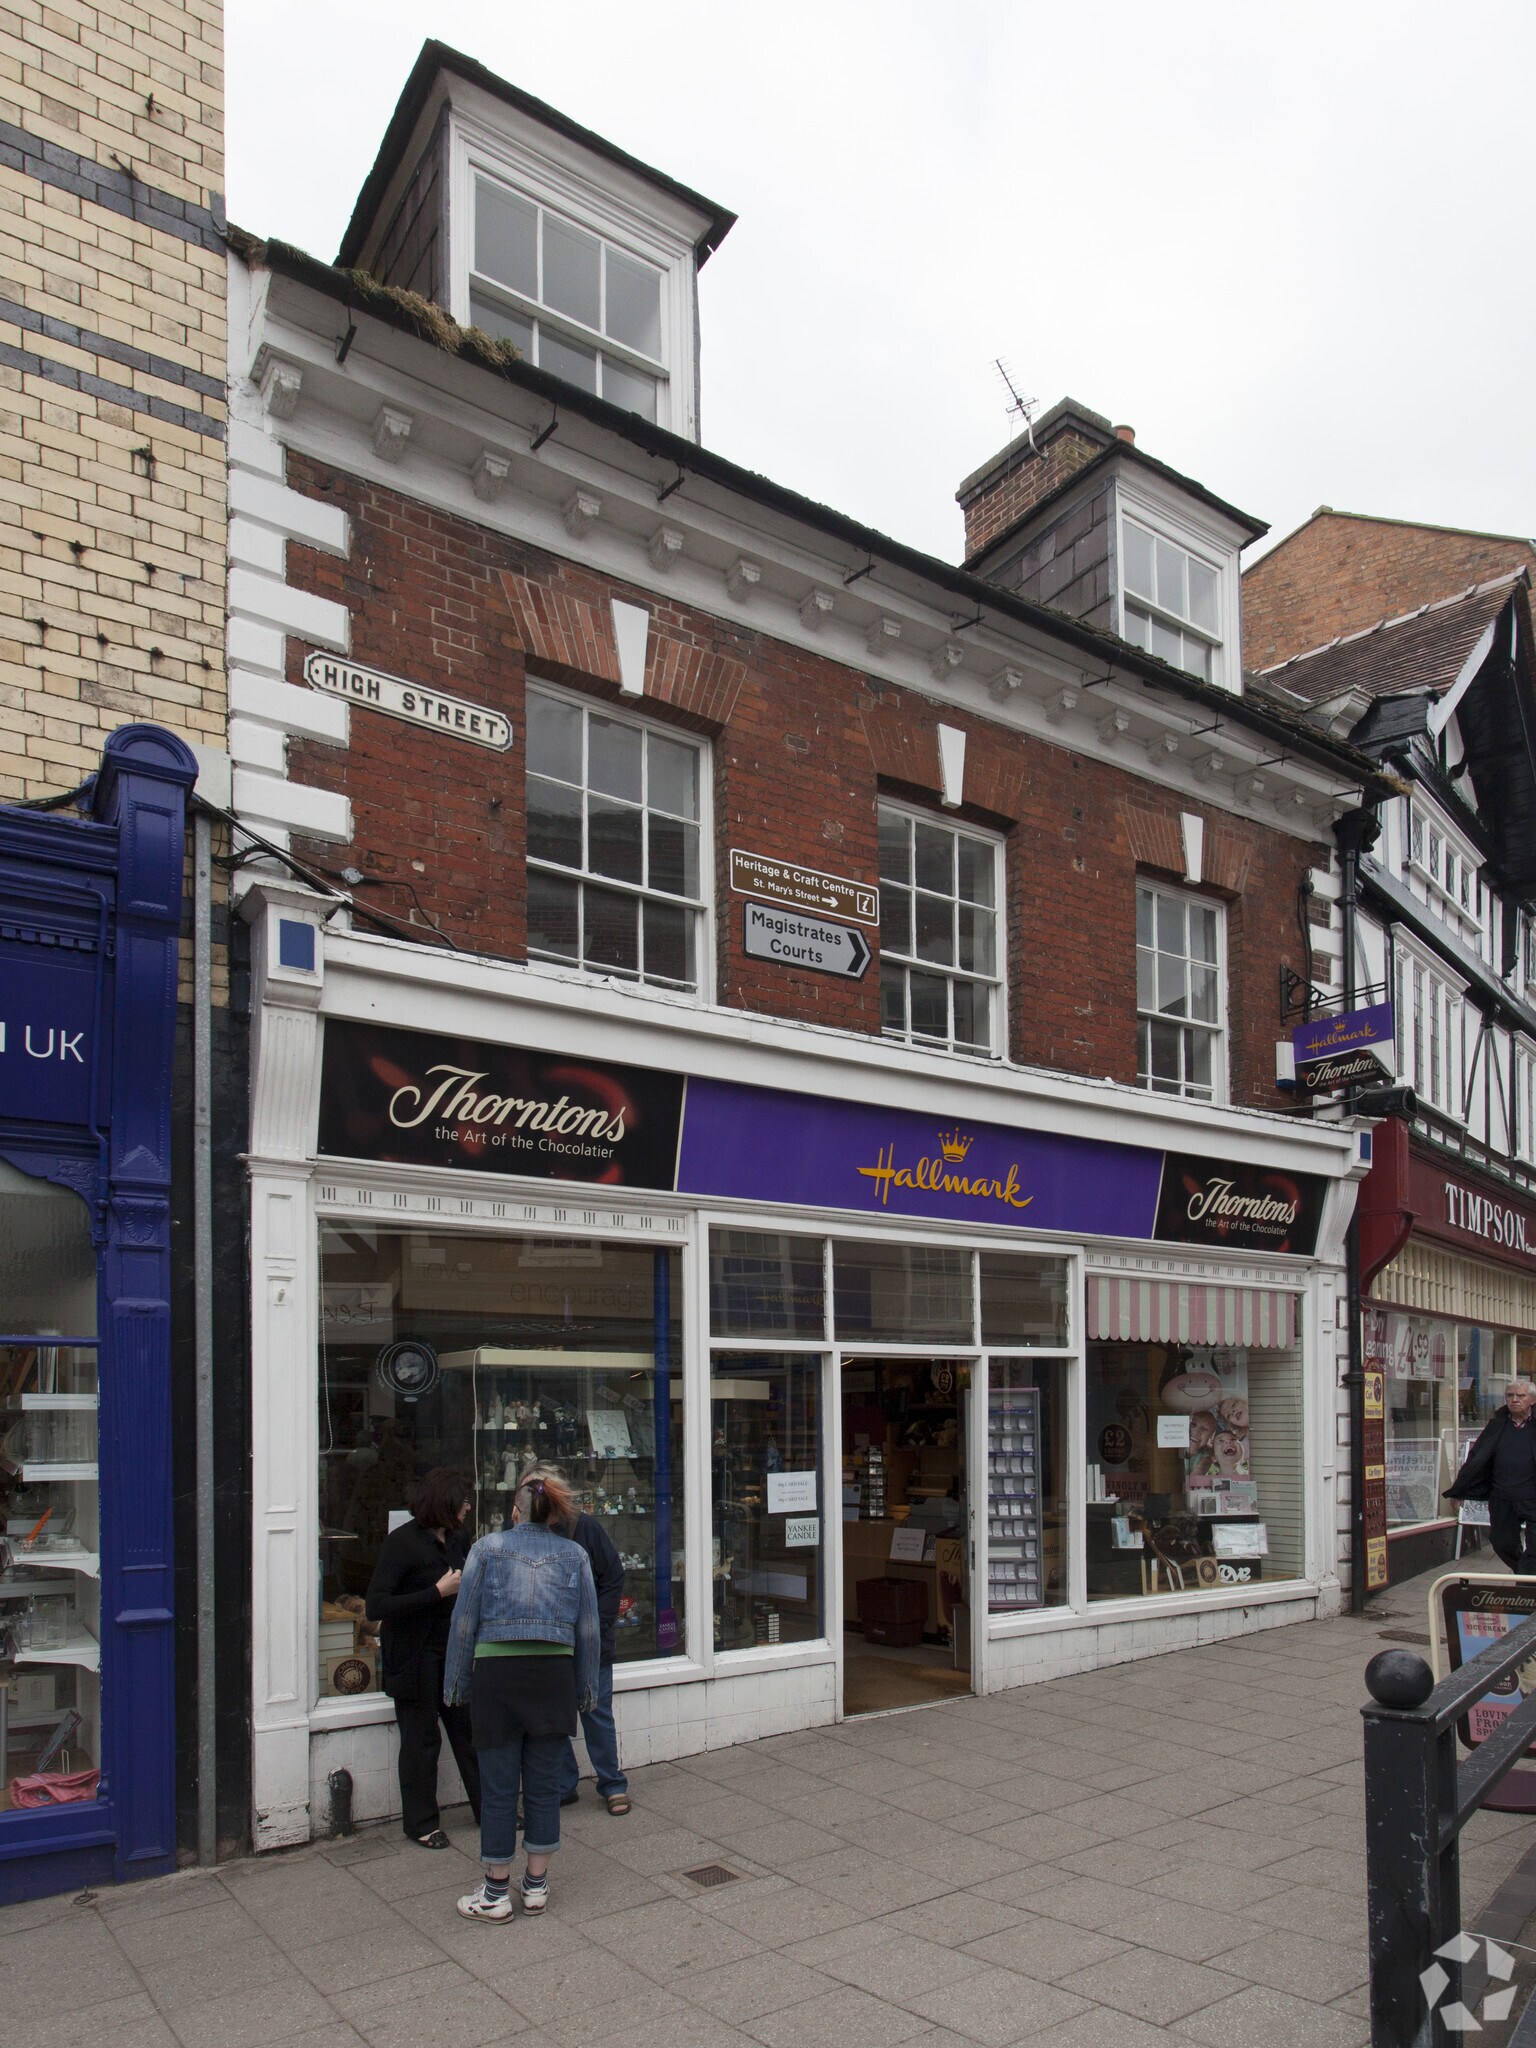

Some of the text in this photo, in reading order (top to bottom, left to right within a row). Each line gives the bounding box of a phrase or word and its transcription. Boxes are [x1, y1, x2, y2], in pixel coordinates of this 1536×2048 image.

[324, 664, 499, 739] HIGH STREET
[735, 855, 855, 897] Heritage & Craft Centre
[753, 877, 820, 903] St. Mary's Street
[751, 910, 842, 946] Magistrates
[770, 938, 823, 963] Courts
[25, 1025, 84, 1063] UK
[1305, 1021, 1378, 1056] Hallmark
[1307, 1058, 1380, 1087] Thorntons
[389, 1064, 626, 1143] Thorntons
[435, 1126, 614, 1159] the Art of the Chocolatier
[856, 1142, 1034, 1208] Hallmark
[1187, 1177, 1298, 1225] Thorntons
[1445, 1182, 1526, 1252] TIMPSON
[1205, 1218, 1287, 1236] the Art of the Chocolatier
[510, 1282, 648, 1313] encourage
[1397, 1326, 1429, 1376] £4.99
[787, 1524, 817, 1533] YANKEE
[787, 1531, 817, 1541] CANDLE
[1483, 1625, 1507, 1633] CREAM
